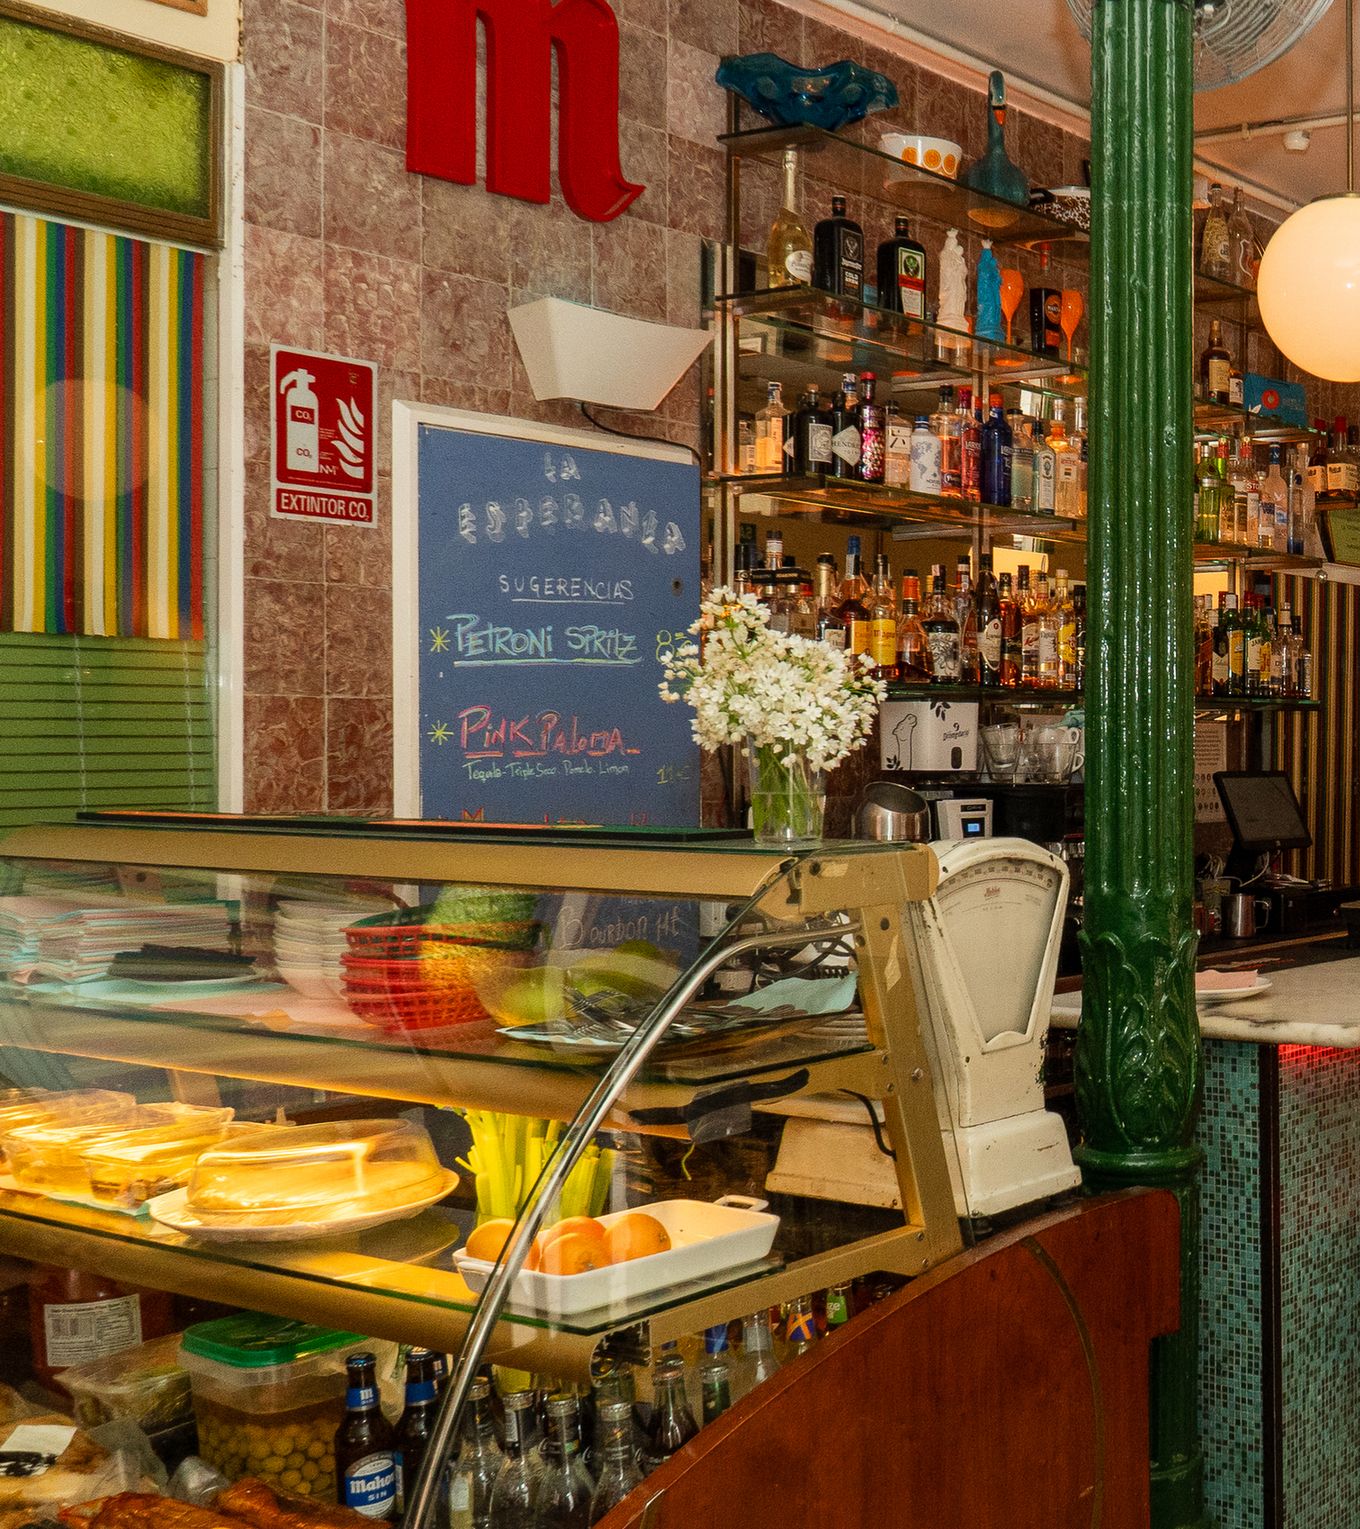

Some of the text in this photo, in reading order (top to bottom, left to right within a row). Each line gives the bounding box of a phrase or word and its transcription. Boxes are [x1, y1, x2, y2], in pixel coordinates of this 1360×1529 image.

[281, 492, 347, 516] EXTINTOR
[458, 493, 686, 555] ESPERANZA
[499, 574, 634, 600] SUGERENCIAS
[368, 1490, 388, 1502] SIN
